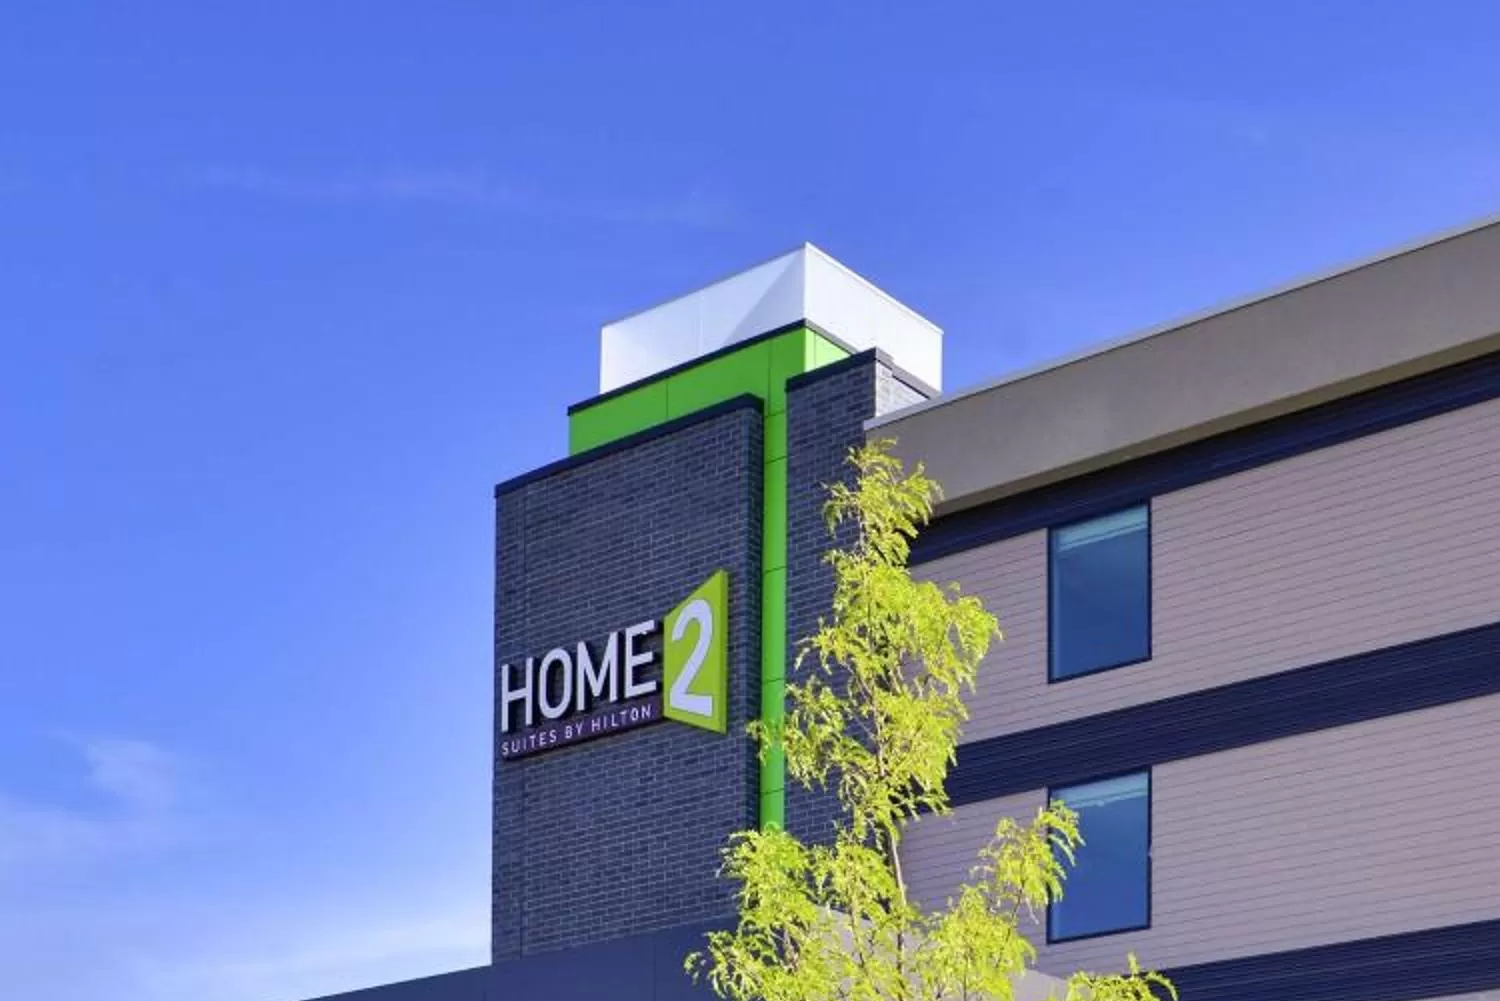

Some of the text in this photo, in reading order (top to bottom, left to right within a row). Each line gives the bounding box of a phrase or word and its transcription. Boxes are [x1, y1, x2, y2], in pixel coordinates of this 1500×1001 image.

[502, 599, 713, 733] HOME 2
[502, 703, 653, 756] SUITES BY HILTON
